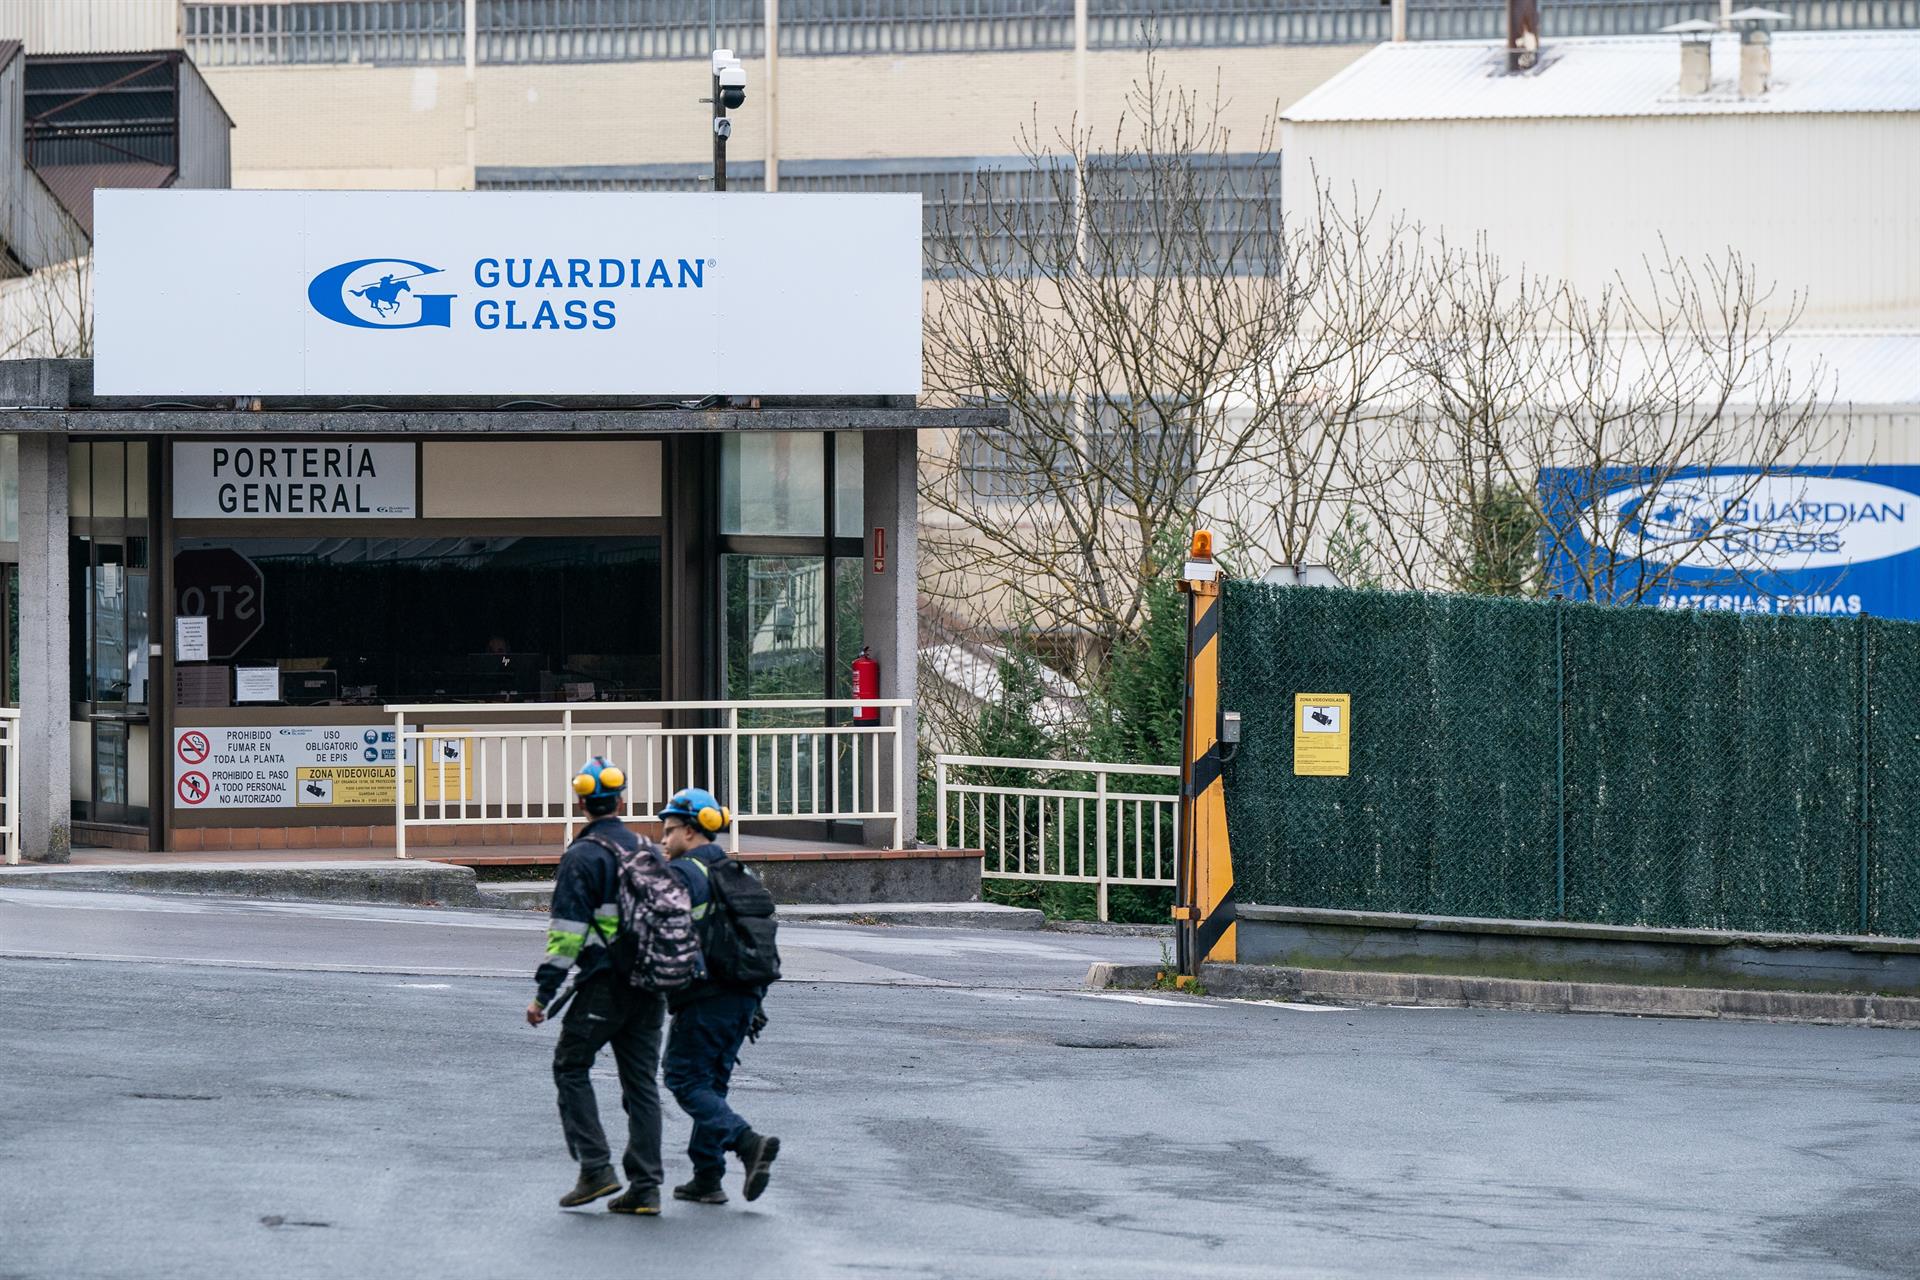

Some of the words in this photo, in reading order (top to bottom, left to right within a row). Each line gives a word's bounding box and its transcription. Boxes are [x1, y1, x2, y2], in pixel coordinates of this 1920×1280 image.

[474, 300, 617, 330] GLASS
[213, 444, 376, 478] PORTERÍA
[218, 483, 370, 513] GENERAL
[1777, 595, 1861, 614] PRIMAS
[227, 731, 272, 740] PROHIBIDO
[324, 730, 340, 739] USO
[228, 743, 256, 751] FUMAR
[260, 743, 271, 751] EN
[305, 742, 358, 751] OBLIGATORIO
[214, 755, 236, 763] TODA
[240, 755, 250, 763] LA
[254, 755, 285, 763] PLANTA
[316, 754, 327, 762] DE
[330, 754, 348, 762] EPIS
[212, 771, 254, 780] PROHIBIDO
[256, 771, 266, 779] EL
[269, 770, 289, 779] PASO
[309, 769, 333, 779] ZONA
[337, 768, 396, 778] VIDEOVIGILAD
[214, 783, 220, 791] A
[222, 783, 243, 791] TODO
[246, 783, 286, 791] PERSONAL
[220, 795, 231, 804] NO
[233, 795, 281, 804] AUTORIZADO
